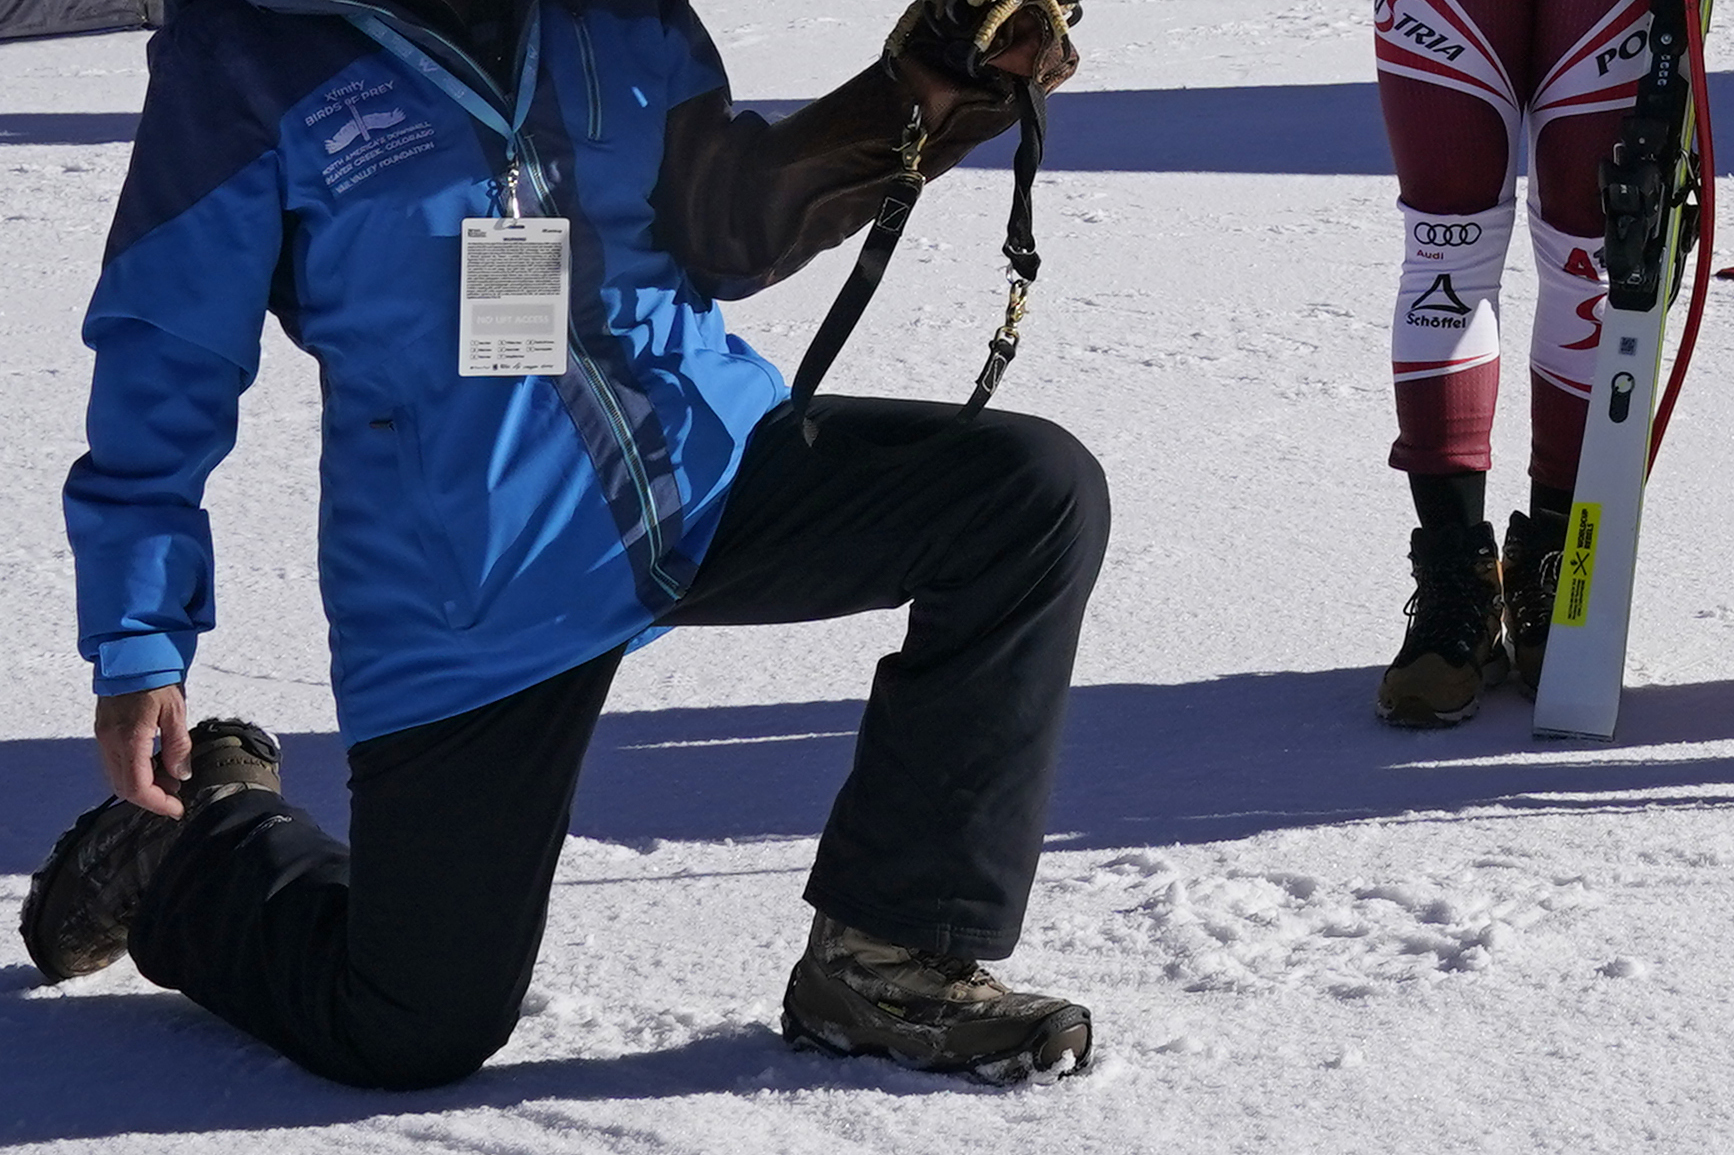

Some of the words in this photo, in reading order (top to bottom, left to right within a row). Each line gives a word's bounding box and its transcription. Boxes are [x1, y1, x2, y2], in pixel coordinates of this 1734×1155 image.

[304, 102, 342, 126] BIRDS
[361, 80, 394, 100] PREY
[1416, 249, 1444, 260] Audi
[1406, 312, 1466, 329] Schöffel
